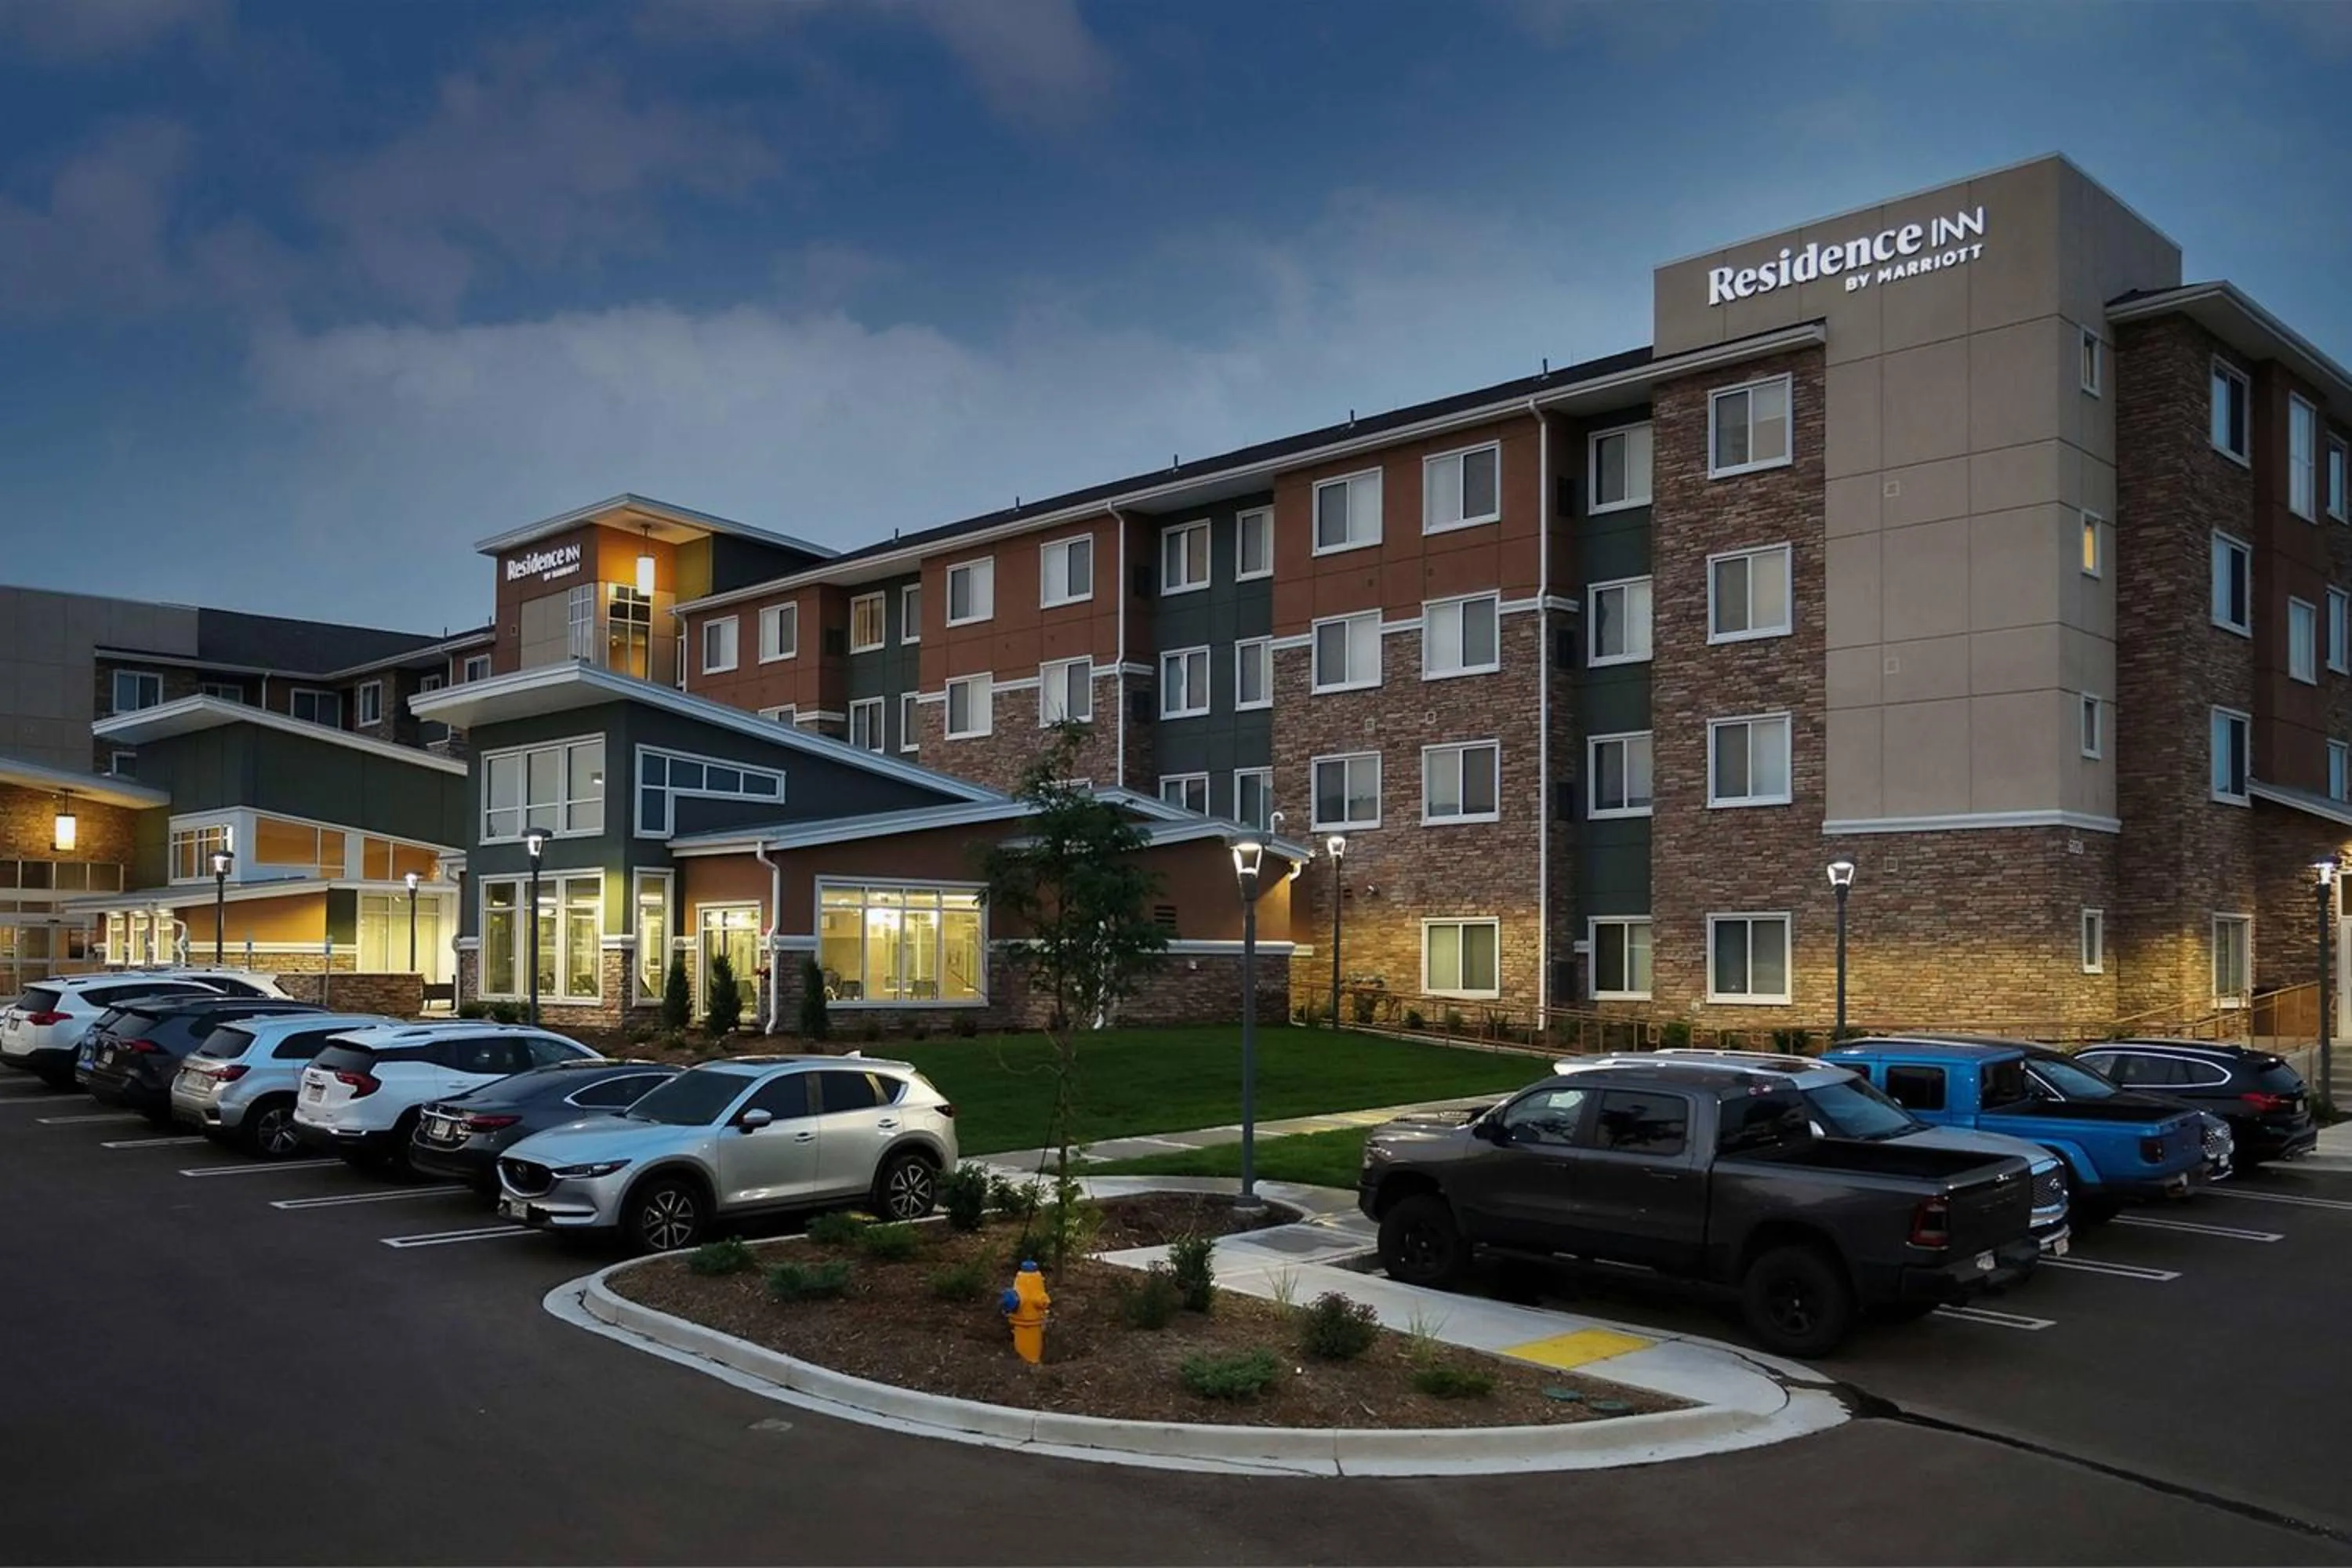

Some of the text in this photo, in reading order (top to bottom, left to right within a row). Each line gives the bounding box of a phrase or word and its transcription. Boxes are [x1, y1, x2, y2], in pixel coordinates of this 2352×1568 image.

[1708, 205, 1984, 306] Residence INN
[1845, 243, 1983, 292] BY MARRIOTT
[506, 548, 565, 581] Residence
